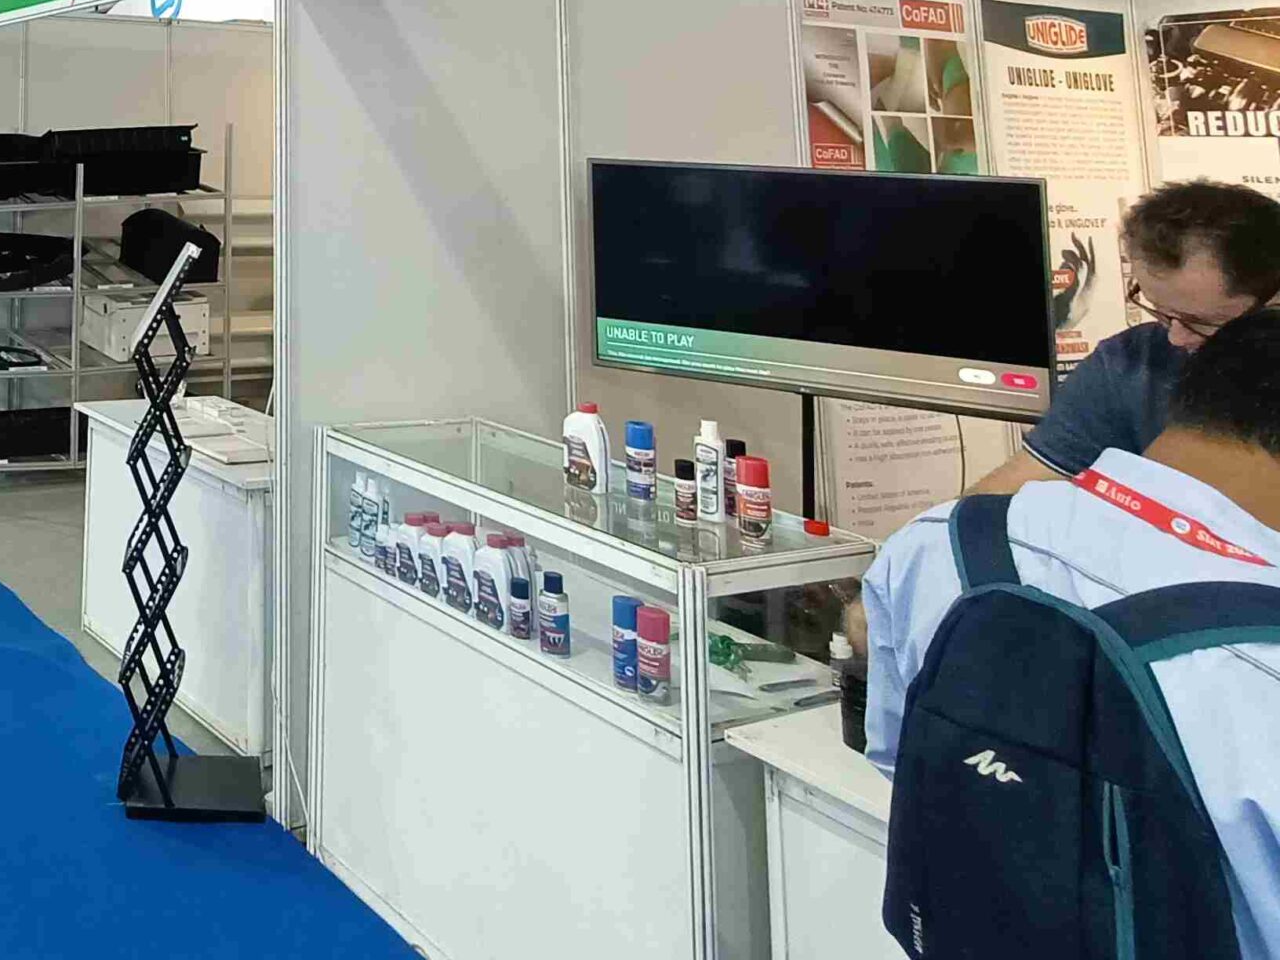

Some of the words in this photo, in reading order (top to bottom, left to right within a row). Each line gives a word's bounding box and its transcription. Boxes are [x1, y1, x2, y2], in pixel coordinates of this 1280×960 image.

[902, 4, 947, 25] CoFAD
[1027, 21, 1086, 47] UNIGLIDE
[1007, 65, 1056, 88] UNIGLIDE
[1065, 71, 1115, 92] UNIGLOVE
[815, 148, 848, 159] CoFAD
[607, 326, 649, 343] UNABLE
[650, 331, 664, 344] TO
[667, 334, 694, 348] PLAY
